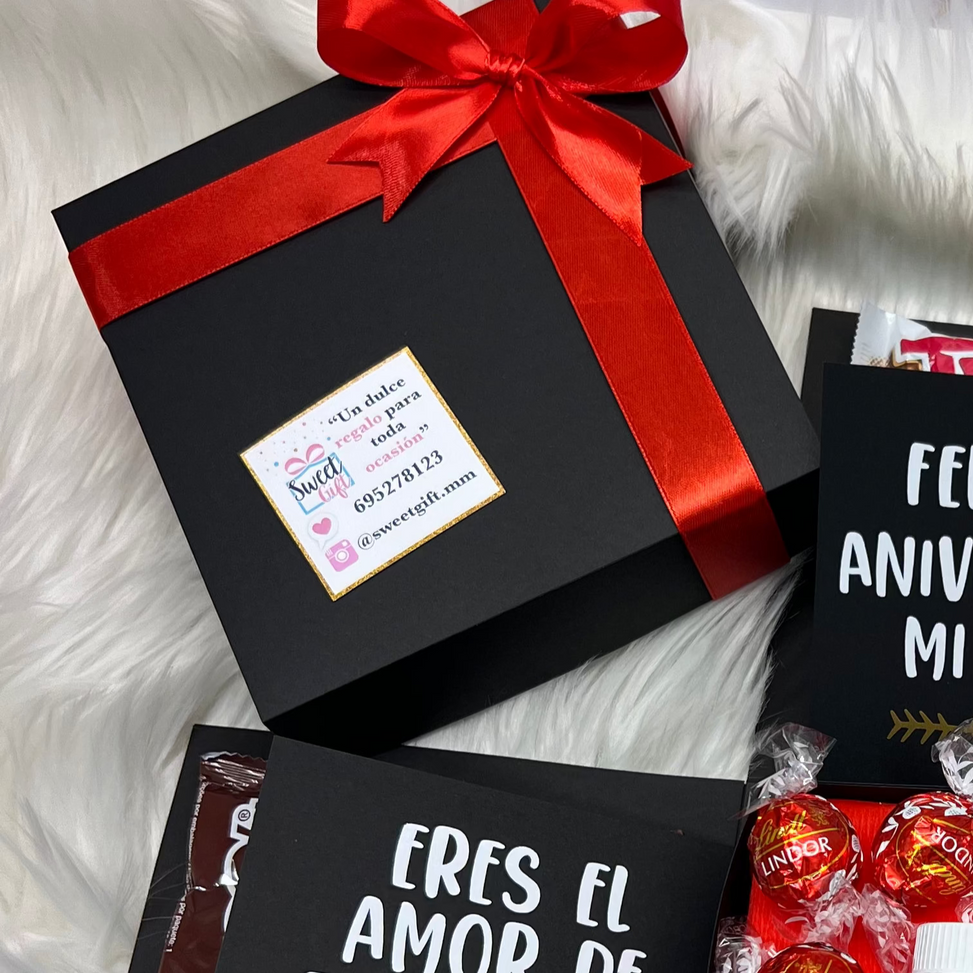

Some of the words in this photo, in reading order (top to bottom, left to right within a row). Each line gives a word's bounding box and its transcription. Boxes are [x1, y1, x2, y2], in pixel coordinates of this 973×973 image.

[364, 376, 407, 408] dulce
[334, 413, 383, 450] regalo
[384, 389, 422, 420] para
[370, 420, 407, 448] toda
[288, 455, 343, 502] Sweet
[317, 472, 352, 503] Gift
[353, 449, 444, 514] 695278123
[357, 469, 478, 551] @sweetgift.mm
[904, 616, 965, 681] MI
[392, 822, 542, 914] ERES
[576, 861, 631, 933] EL
[760, 835, 833, 877] LINDOR
